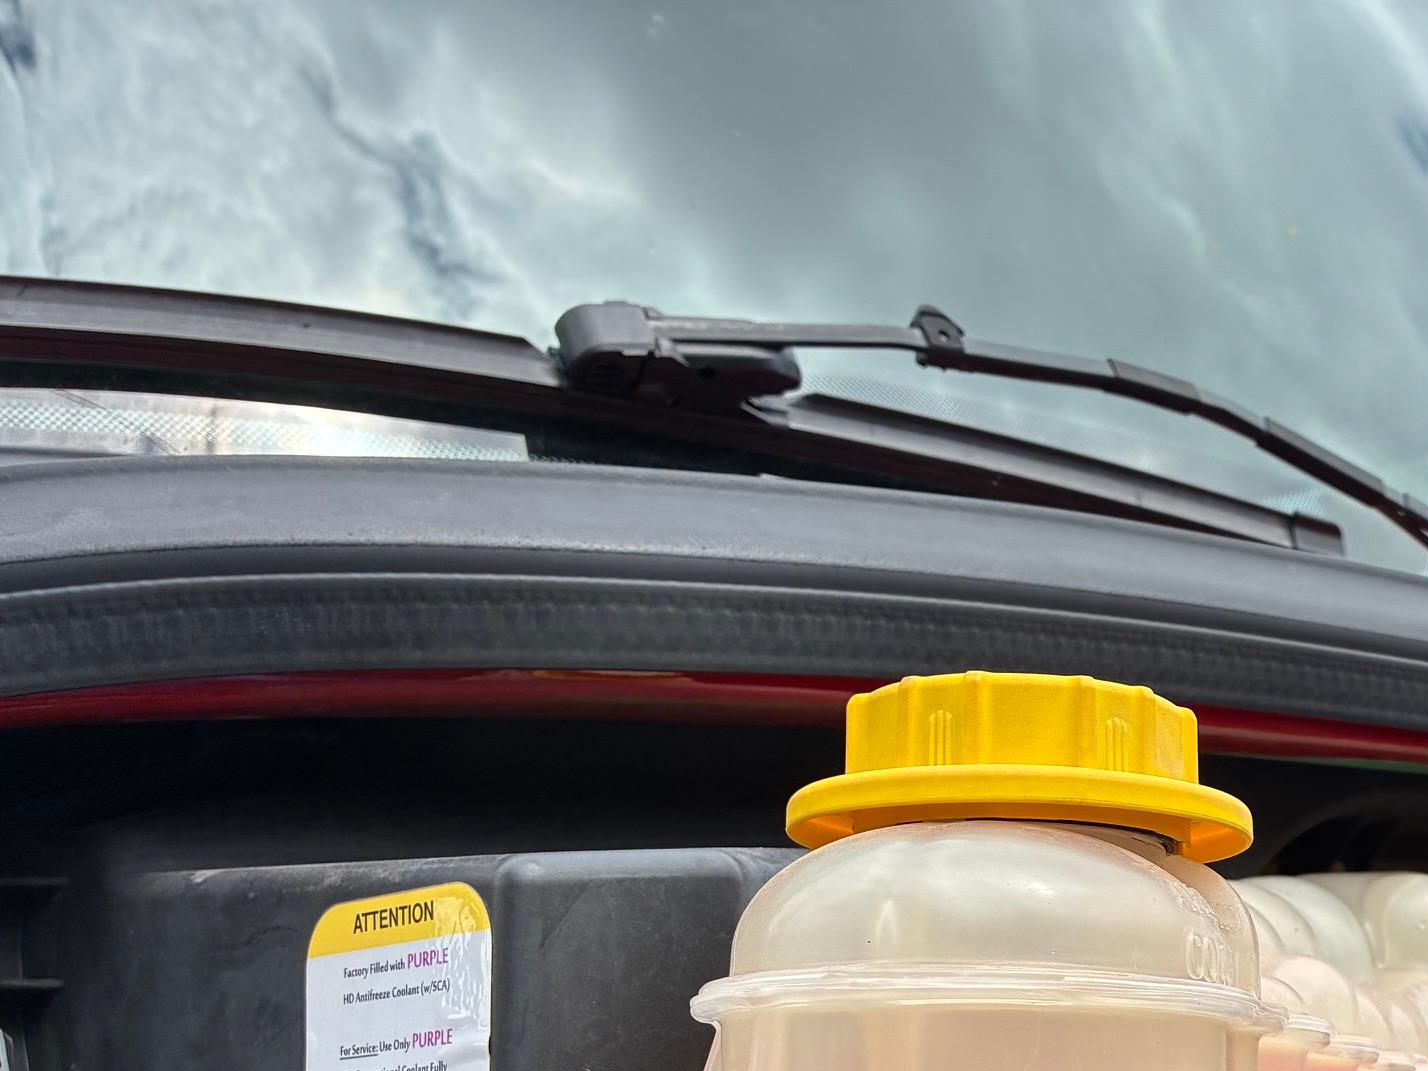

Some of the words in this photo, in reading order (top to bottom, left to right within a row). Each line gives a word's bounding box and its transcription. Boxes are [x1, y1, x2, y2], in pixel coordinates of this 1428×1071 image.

[353, 900, 434, 934] ATTENTION
[344, 967, 369, 979] Factory
[370, 961, 388, 975] Filled
[390, 958, 405, 971] with
[407, 948, 448, 969] PURPLE
[343, 993, 354, 1005] HD
[355, 989, 390, 1003] Antifreeze
[392, 984, 419, 998] Coolant
[421, 978, 450, 997] (w/SCA)
[340, 1045, 351, 1057] For
[352, 1043, 378, 1055] Service:
[379, 1041, 392, 1052] Use
[394, 1038, 411, 1053] Only
[412, 1028, 453, 1049] PURPLE
